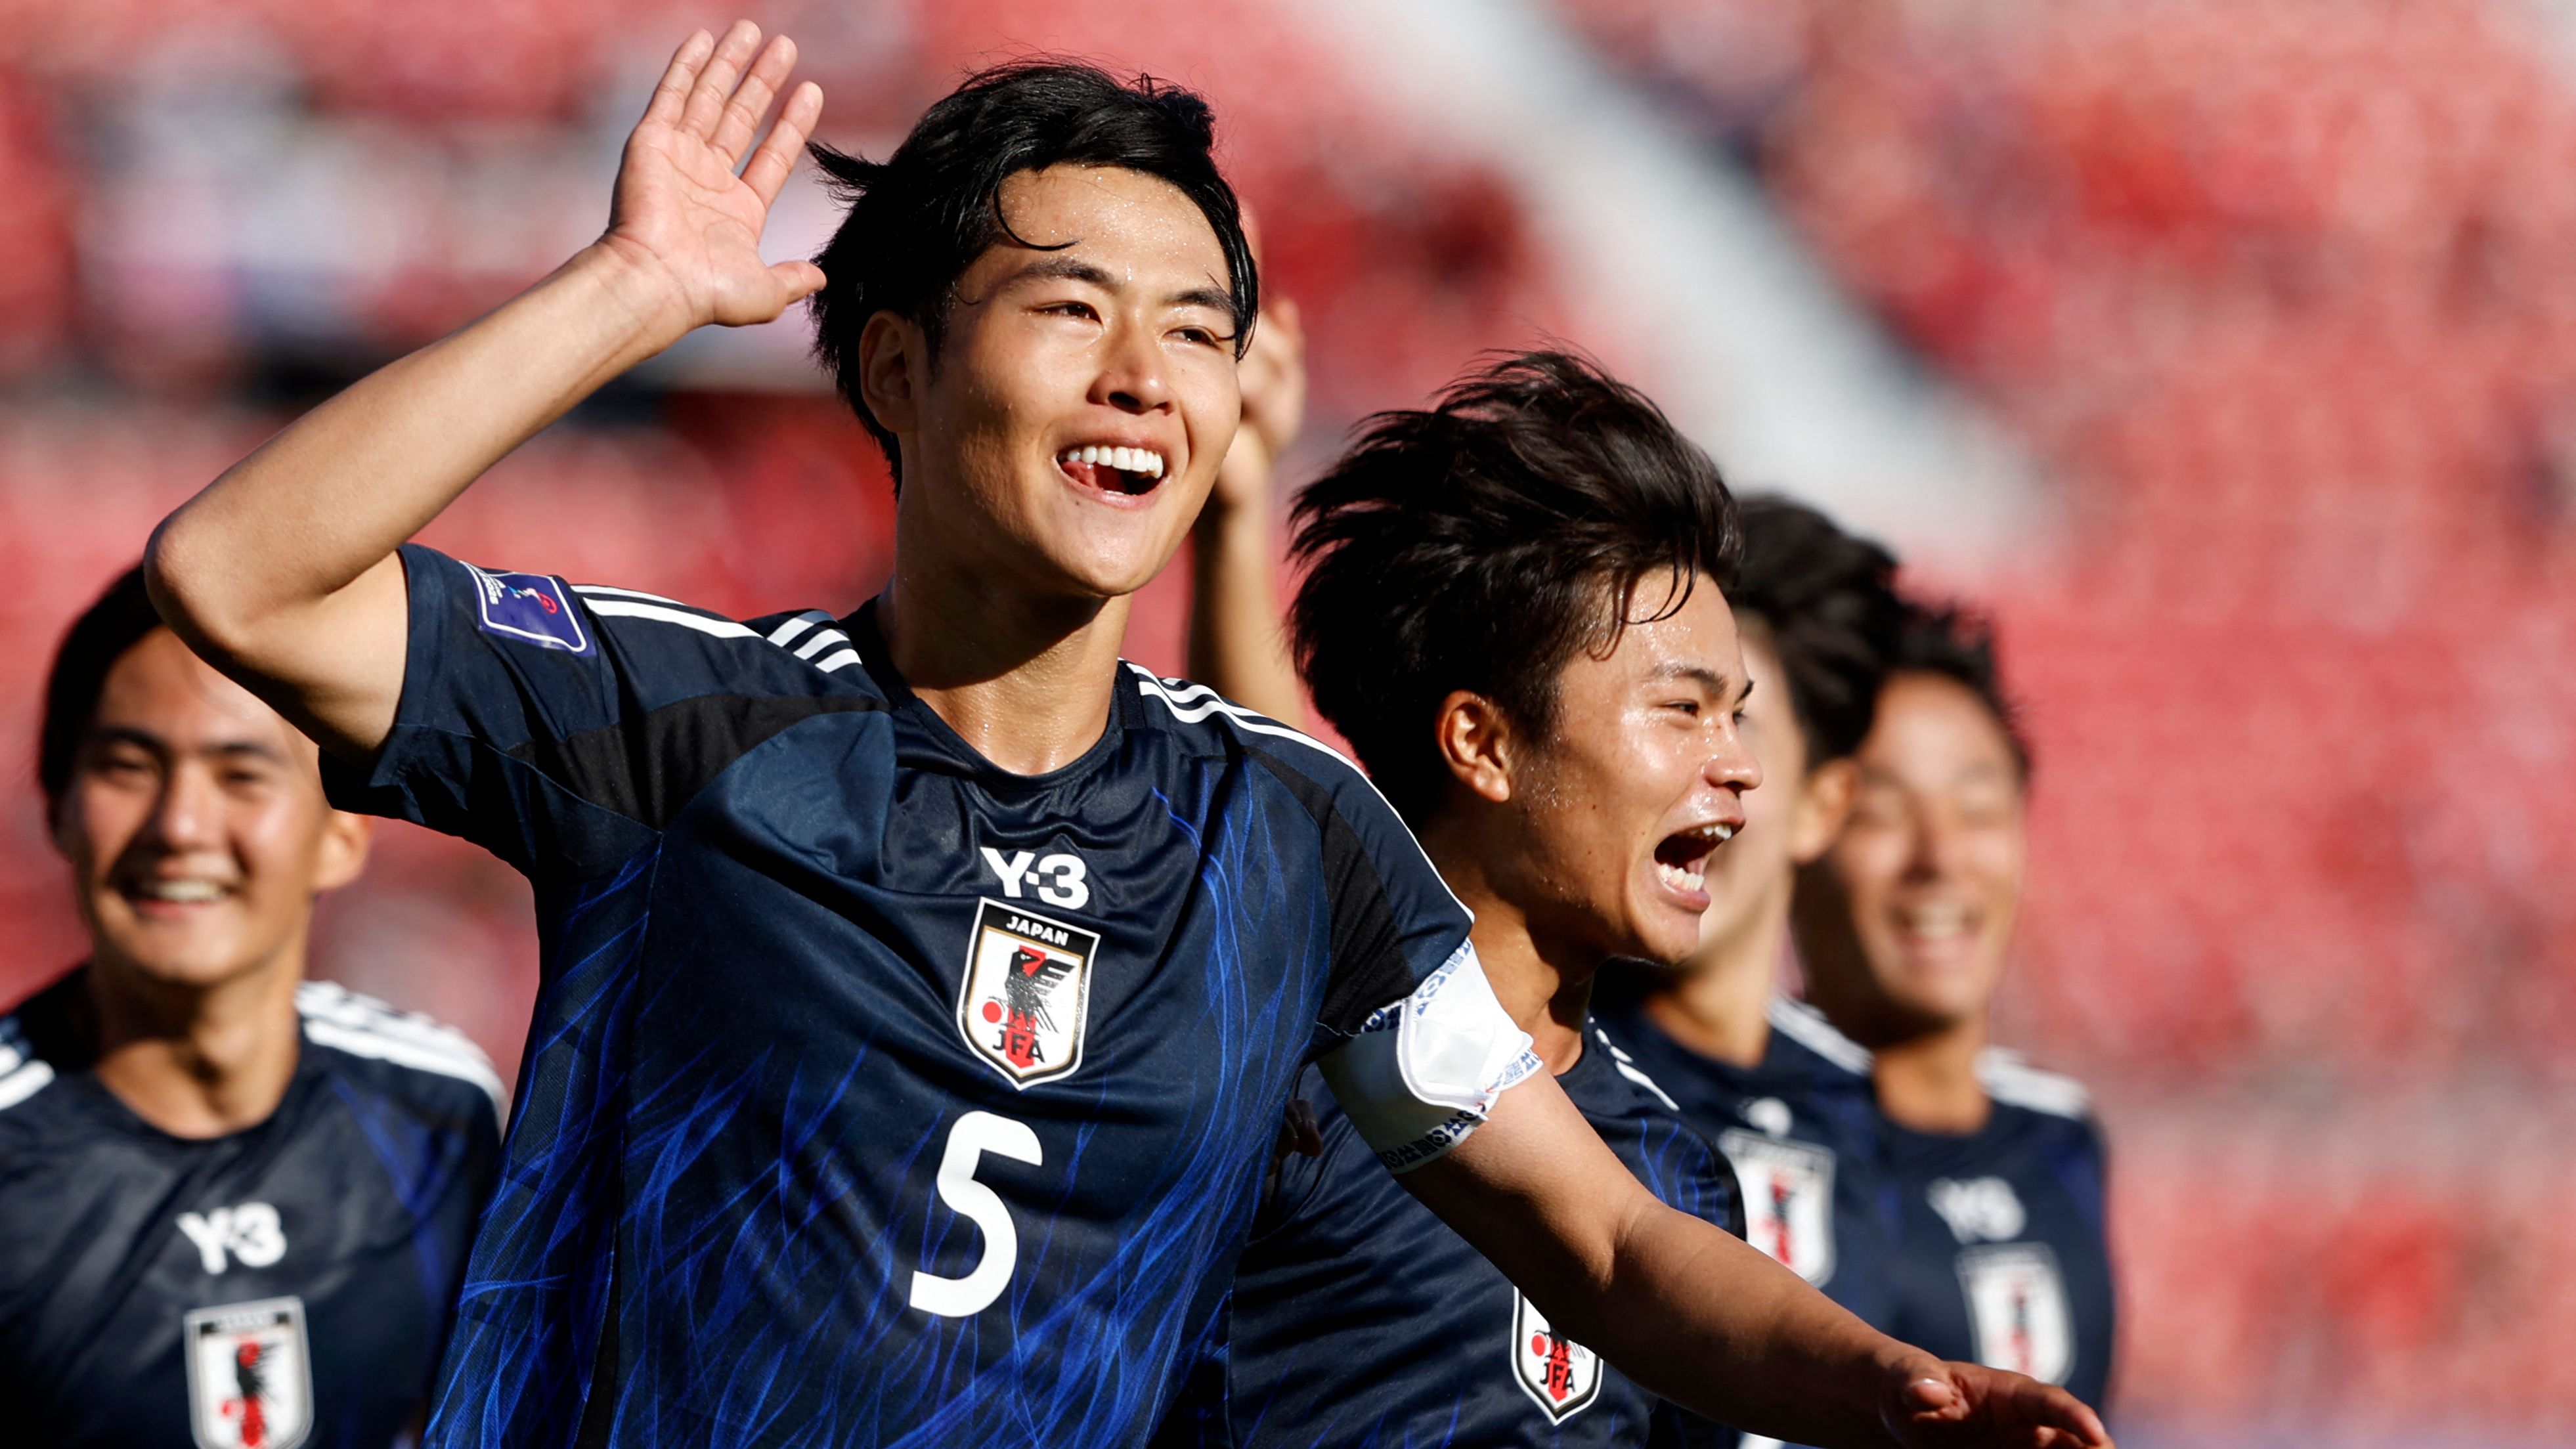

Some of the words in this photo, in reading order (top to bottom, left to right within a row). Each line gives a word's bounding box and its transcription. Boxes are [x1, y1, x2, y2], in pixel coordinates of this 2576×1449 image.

[979, 846, 1090, 910] Y-3
[1005, 916, 1070, 947] JAPAN
[992, 1029, 1046, 1064] JFA
[909, 1110, 1043, 1318] 5
[1539, 1362, 1576, 1393] JFA
